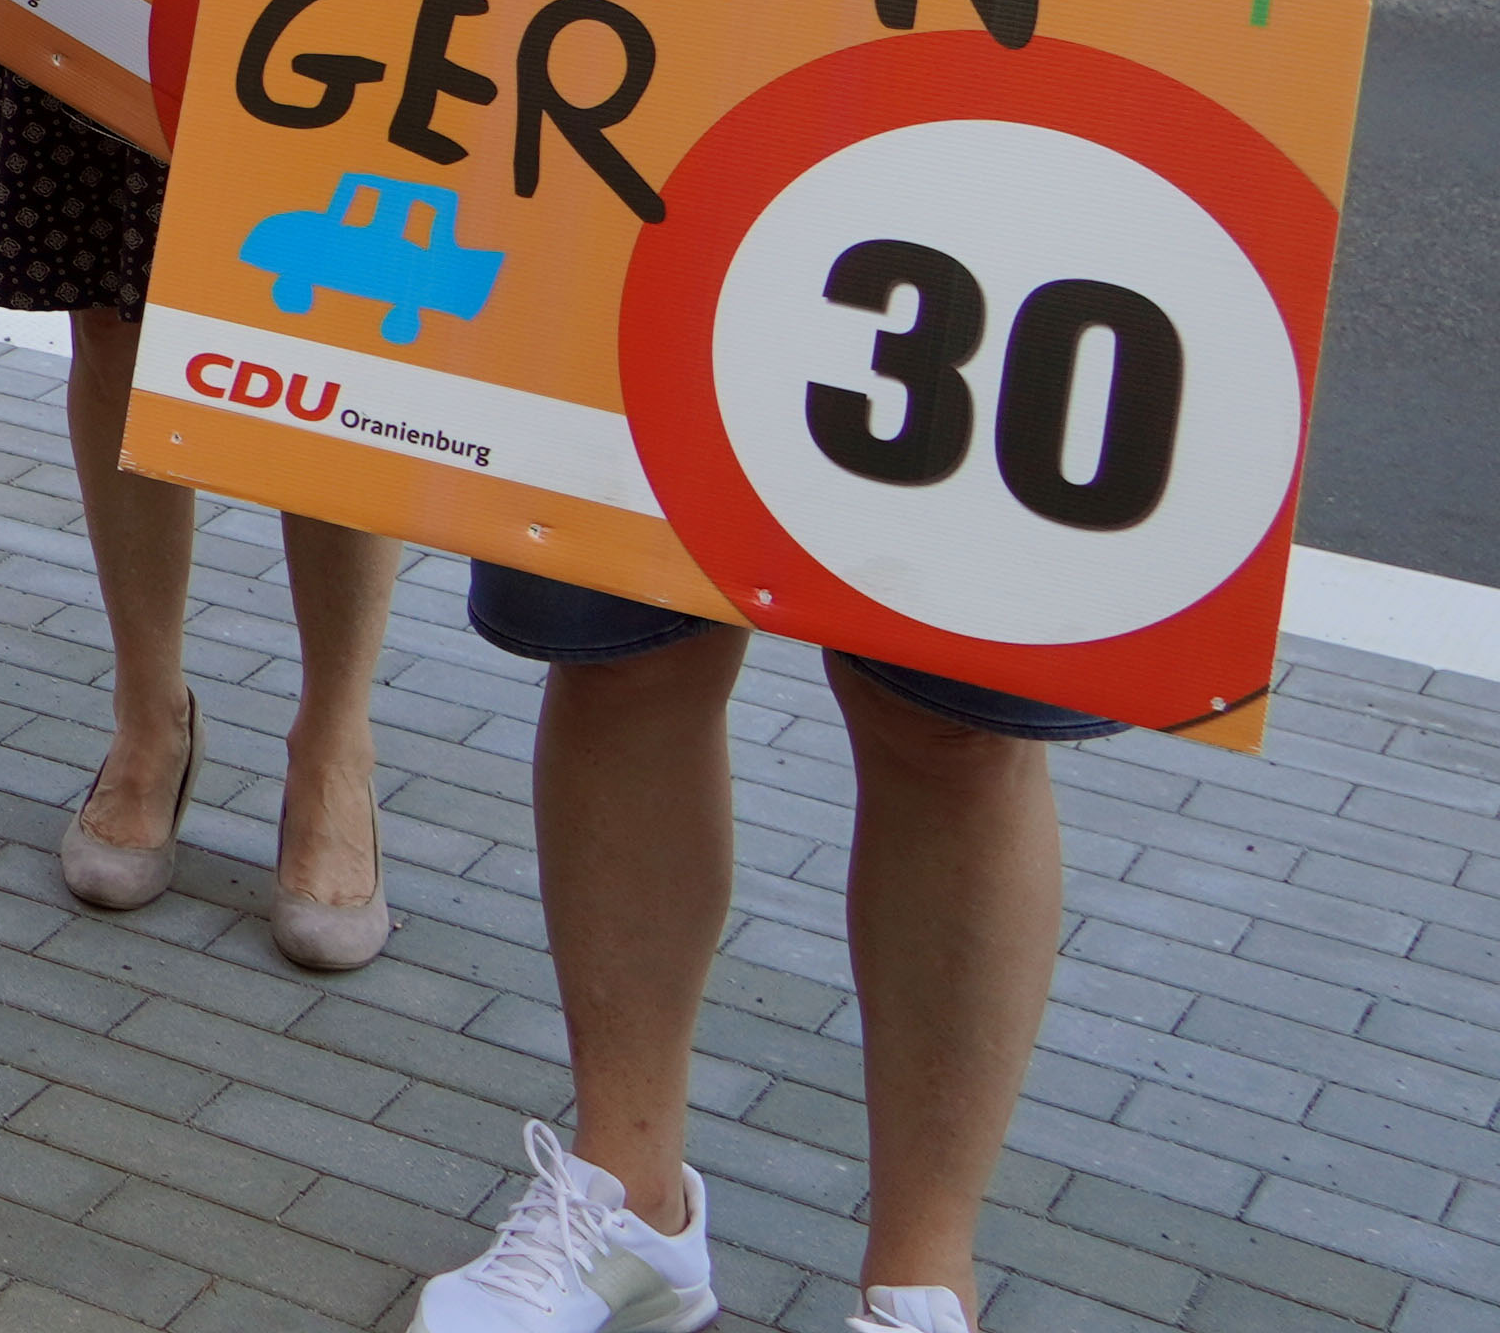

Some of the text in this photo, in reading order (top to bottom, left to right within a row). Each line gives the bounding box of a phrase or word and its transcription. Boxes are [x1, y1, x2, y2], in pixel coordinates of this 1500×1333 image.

[185, 353, 491, 467] CDU Oranienburg
[803, 238, 1186, 532] 30
